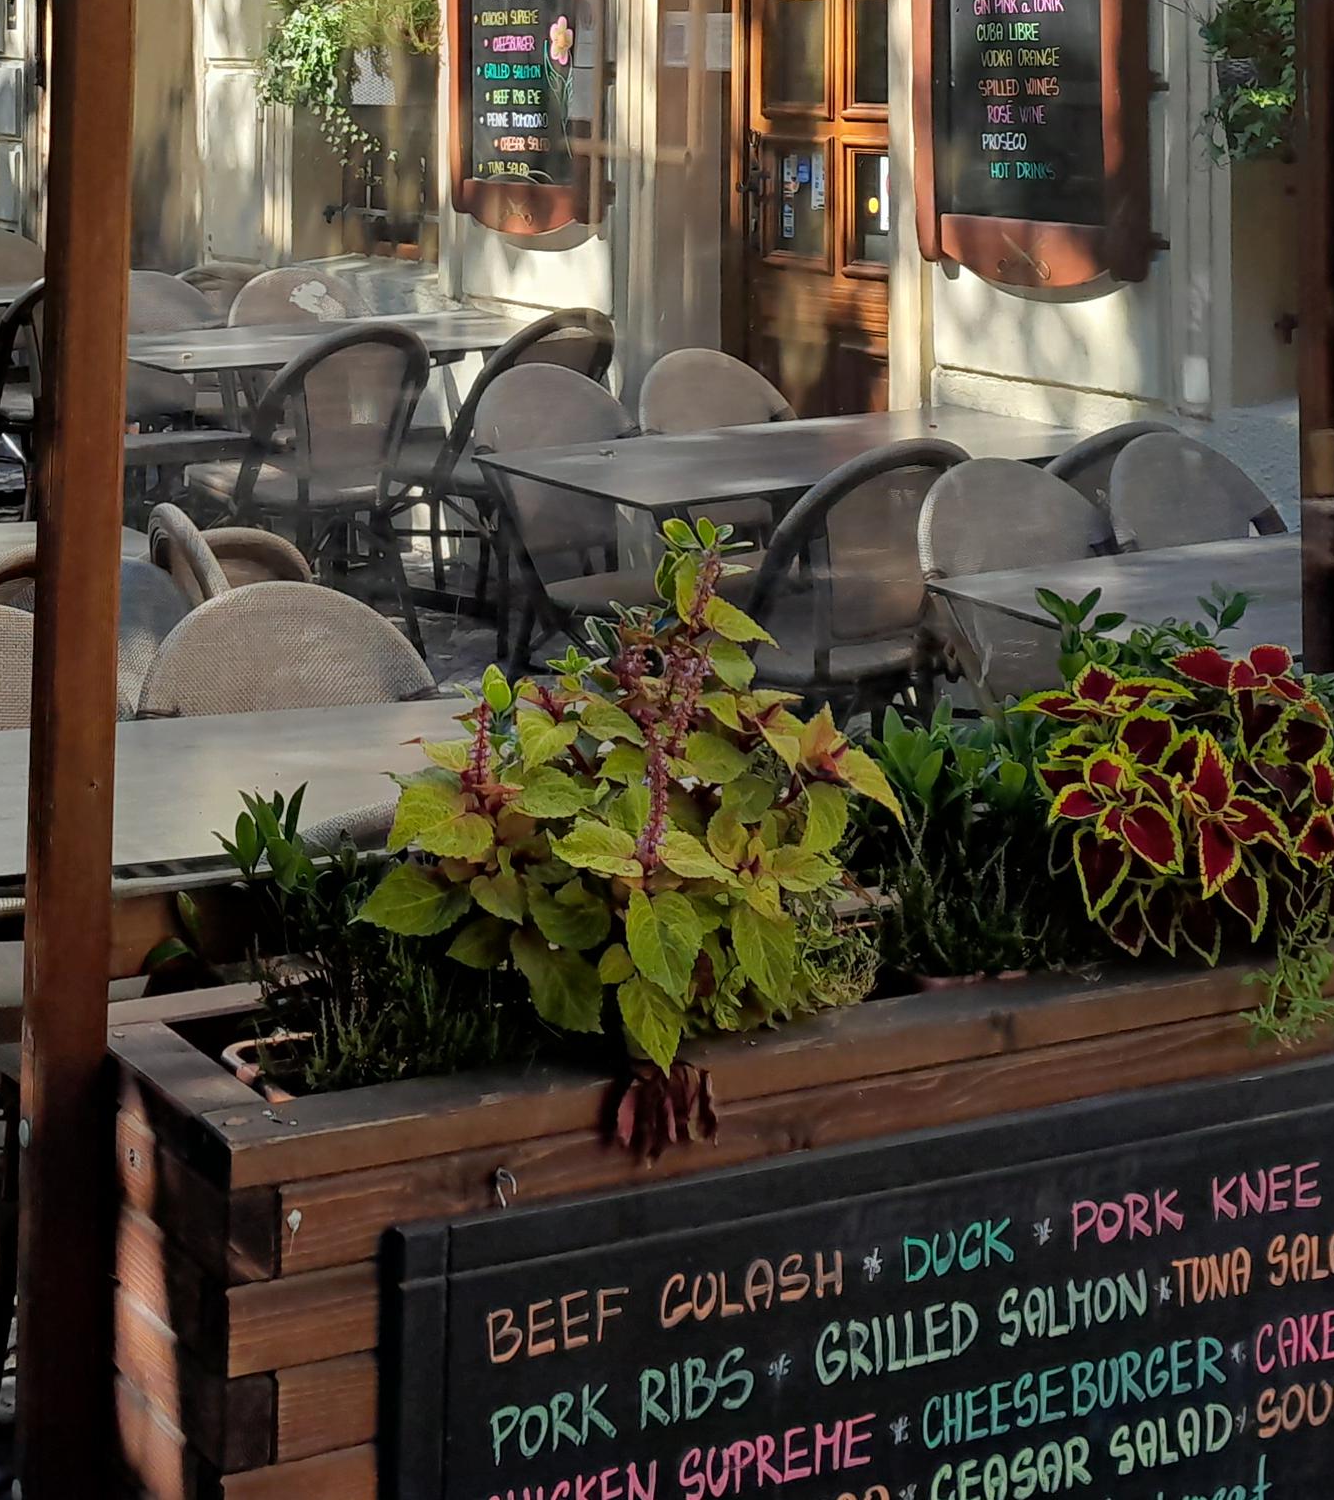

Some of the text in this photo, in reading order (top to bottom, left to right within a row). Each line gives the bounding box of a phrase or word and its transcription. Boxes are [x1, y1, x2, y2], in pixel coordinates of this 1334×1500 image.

[977, 23, 1040, 41] CUBA LIBRE
[981, 47, 1060, 67] VODKA ORANGE
[978, 77, 1060, 96] SPILLED WINES
[493, 89, 511, 104] BEEF
[1019, 105, 1046, 124] WINE
[991, 161, 1055, 180] HOT DRINKS
[486, 1161, 1322, 1364] BEEF GULASH DUCK PORK KNEE
[489, 1383, 617, 1466] PORK
[639, 1346, 755, 1430] RIBS
[815, 1301, 979, 1386] GRILLED
[999, 1268, 1148, 1346] SALMON
[1172, 1247, 1251, 1307] TUNA
[678, 1413, 877, 1500] SUPREME
[922, 1337, 1227, 1450] CHEESEBURGER
[930, 1436, 1093, 1500] CEASAR
[1109, 1403, 1233, 1476] SALAD
